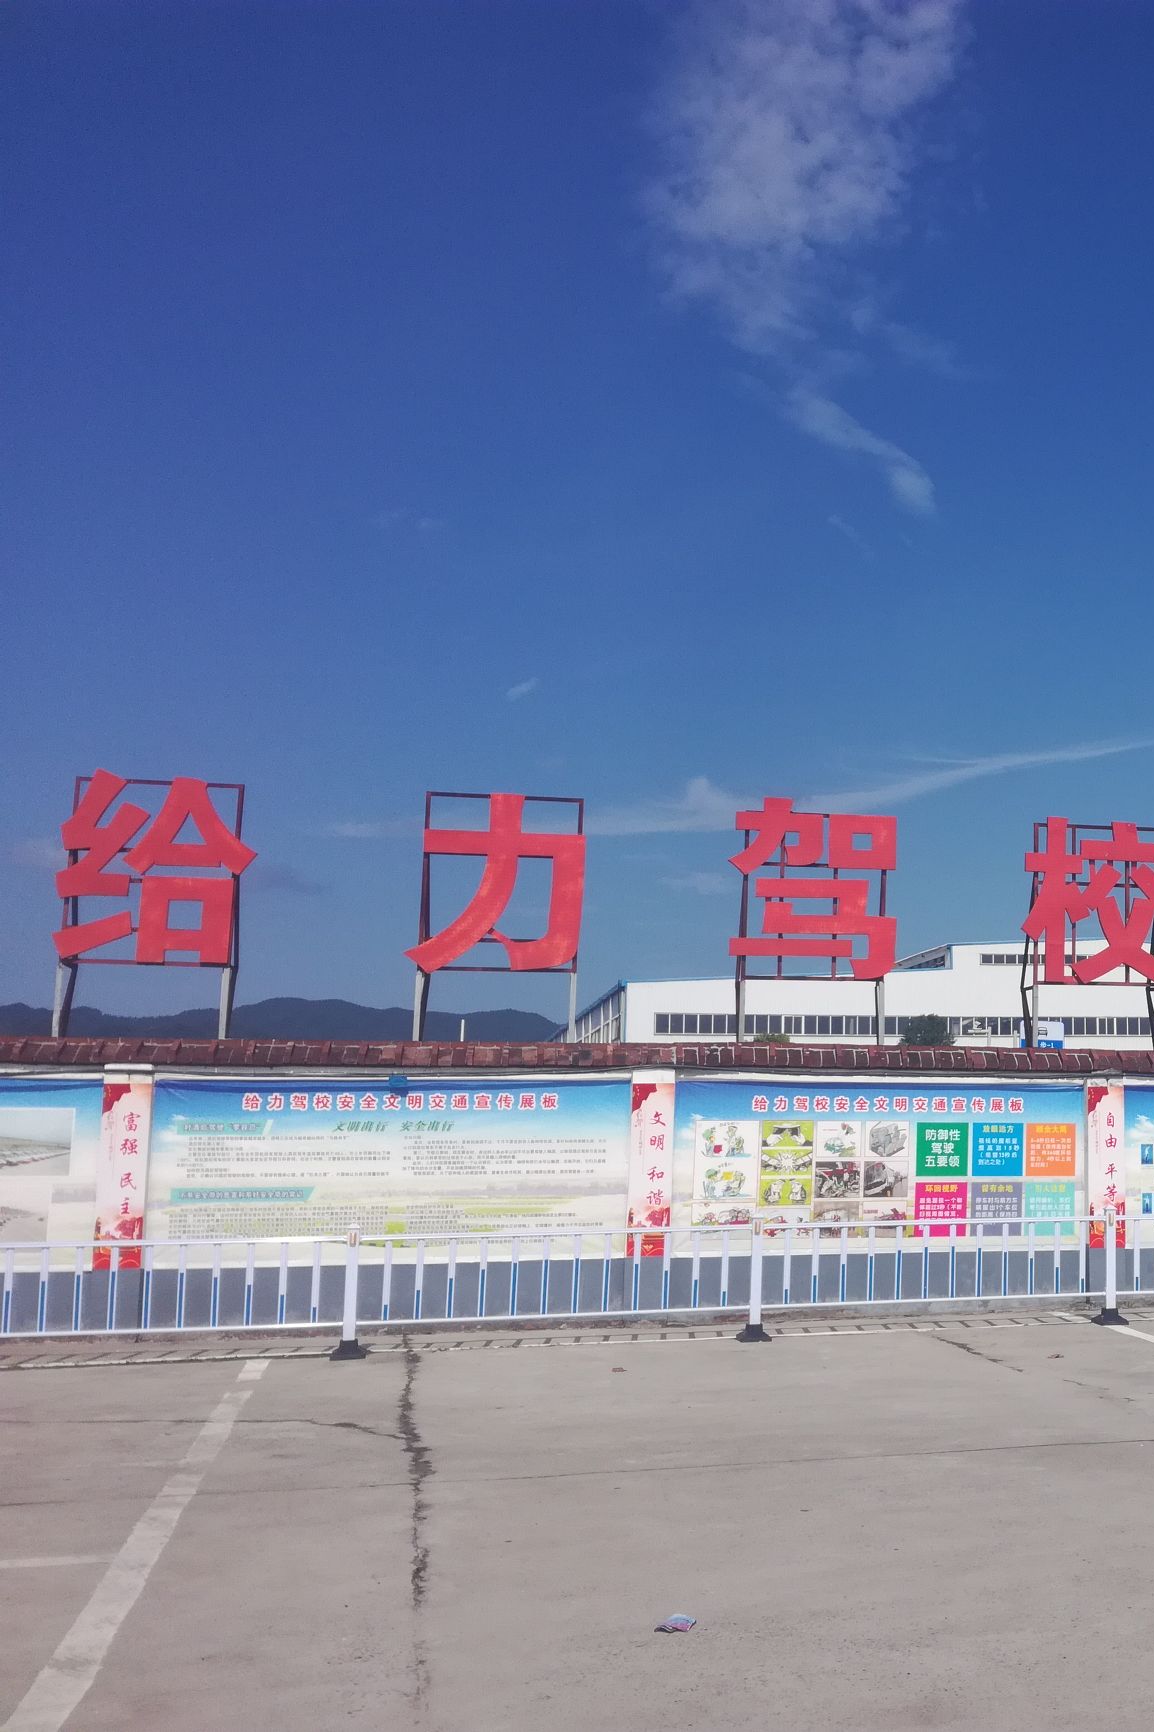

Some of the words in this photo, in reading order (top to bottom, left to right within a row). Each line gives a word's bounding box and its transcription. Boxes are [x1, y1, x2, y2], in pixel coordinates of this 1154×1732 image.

[242, 1093, 558, 1111] 给力驾校安全文明交通宣传展板
[752, 1096, 1024, 1113] 给力驾校安全文明交通宣传展板
[119, 1112, 141, 1155] 富强
[649, 1111, 666, 1150] 文明
[925, 1128, 961, 1141] 防御性
[931, 1142, 955, 1154] 驾驶
[1105, 1112, 1118, 1149] 自由
[924, 1155, 960, 1168] 五要领
[119, 1172, 137, 1215] 民主
[646, 1166, 664, 1205] 和谐
[1104, 1163, 1118, 1202] 平等
